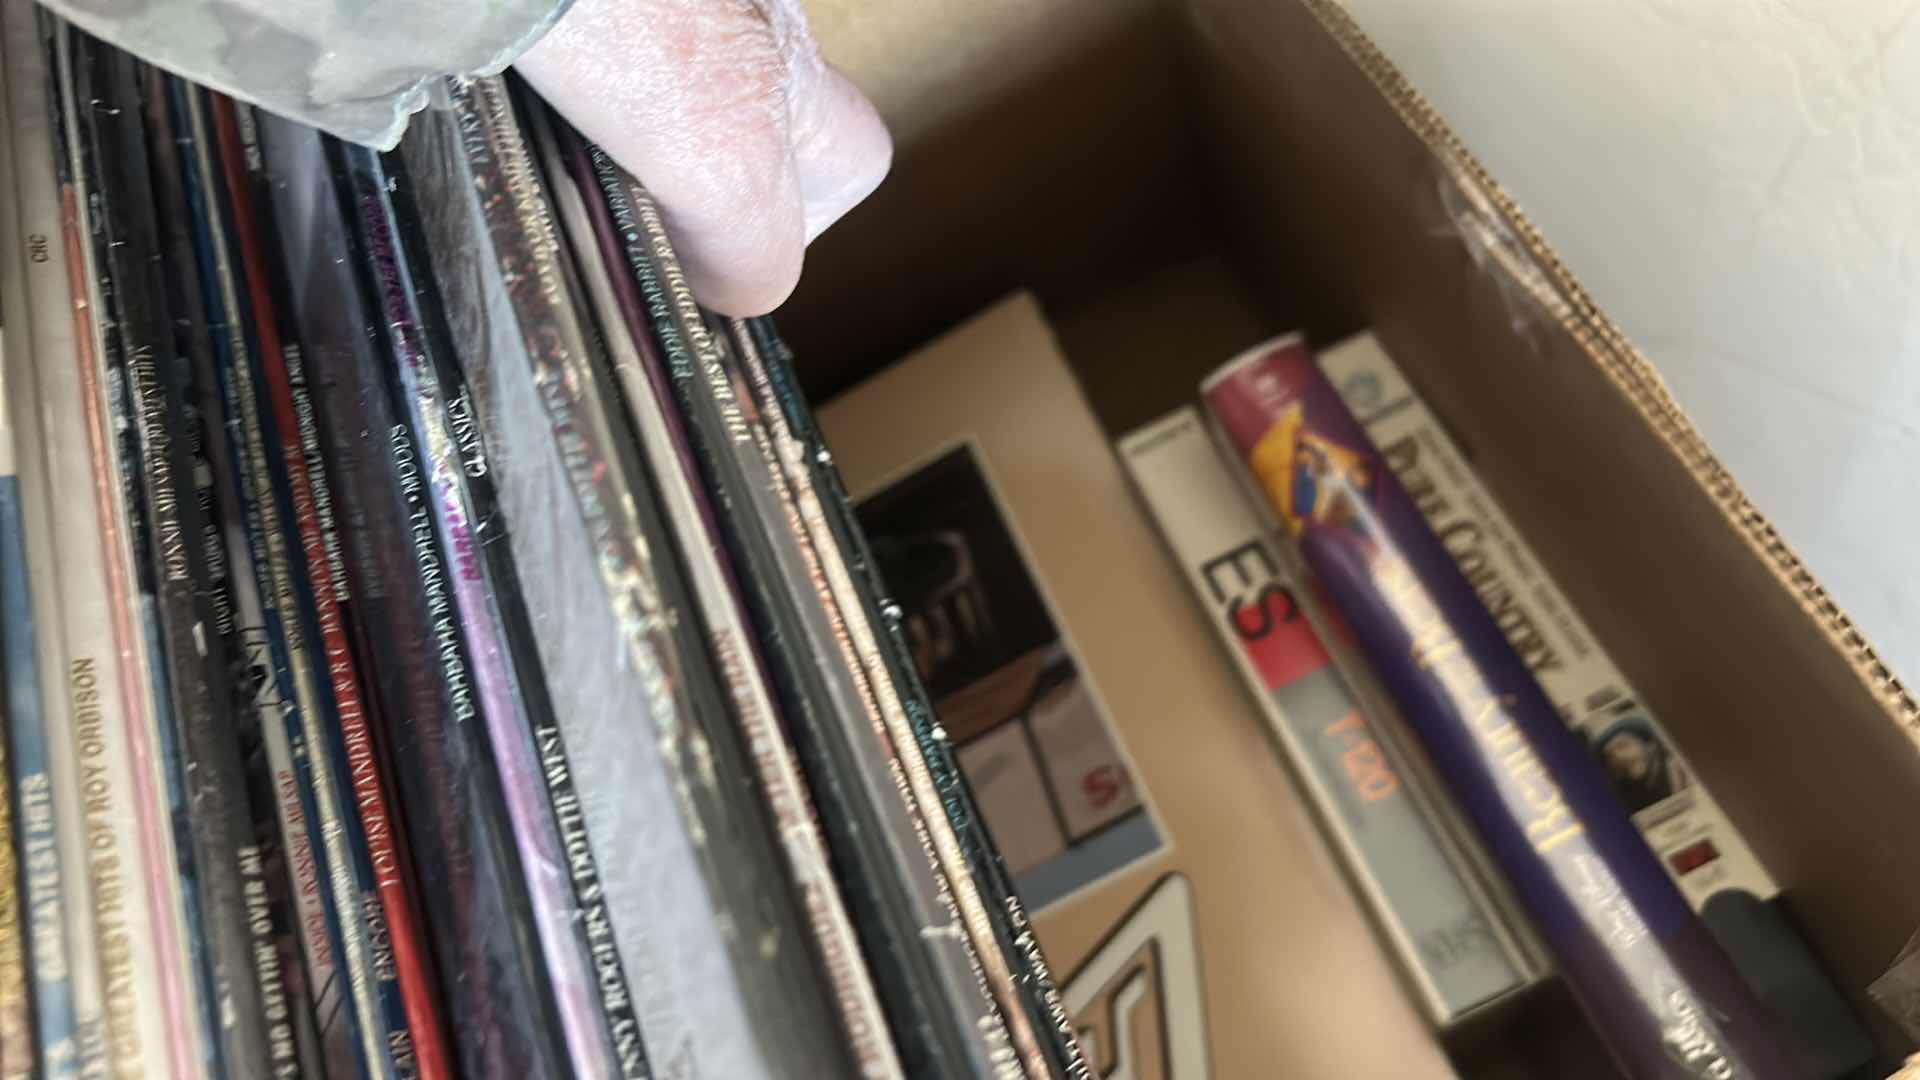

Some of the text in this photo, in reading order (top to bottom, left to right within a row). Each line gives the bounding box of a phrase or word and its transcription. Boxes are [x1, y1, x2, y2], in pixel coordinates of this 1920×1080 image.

[383, 422, 423, 495] MOODS
[444, 394, 490, 480] CLASSICS
[157, 518, 190, 582] RONNIE
[319, 529, 353, 602] BARBARA
[402, 505, 453, 616] MANDRELL
[1202, 539, 1299, 642] ES
[68, 656, 107, 758] ORBISON
[430, 616, 477, 722] BARBARA
[80, 761, 113, 813] ROY
[333, 697, 384, 809] MANDRELL
[532, 721, 573, 788] WEST
[234, 844, 264, 877] ME
[360, 809, 401, 888] LOUISE
[550, 792, 598, 880] DOTTIE
[238, 877, 275, 938] OVER
[578, 904, 631, 1013] ROGERS
